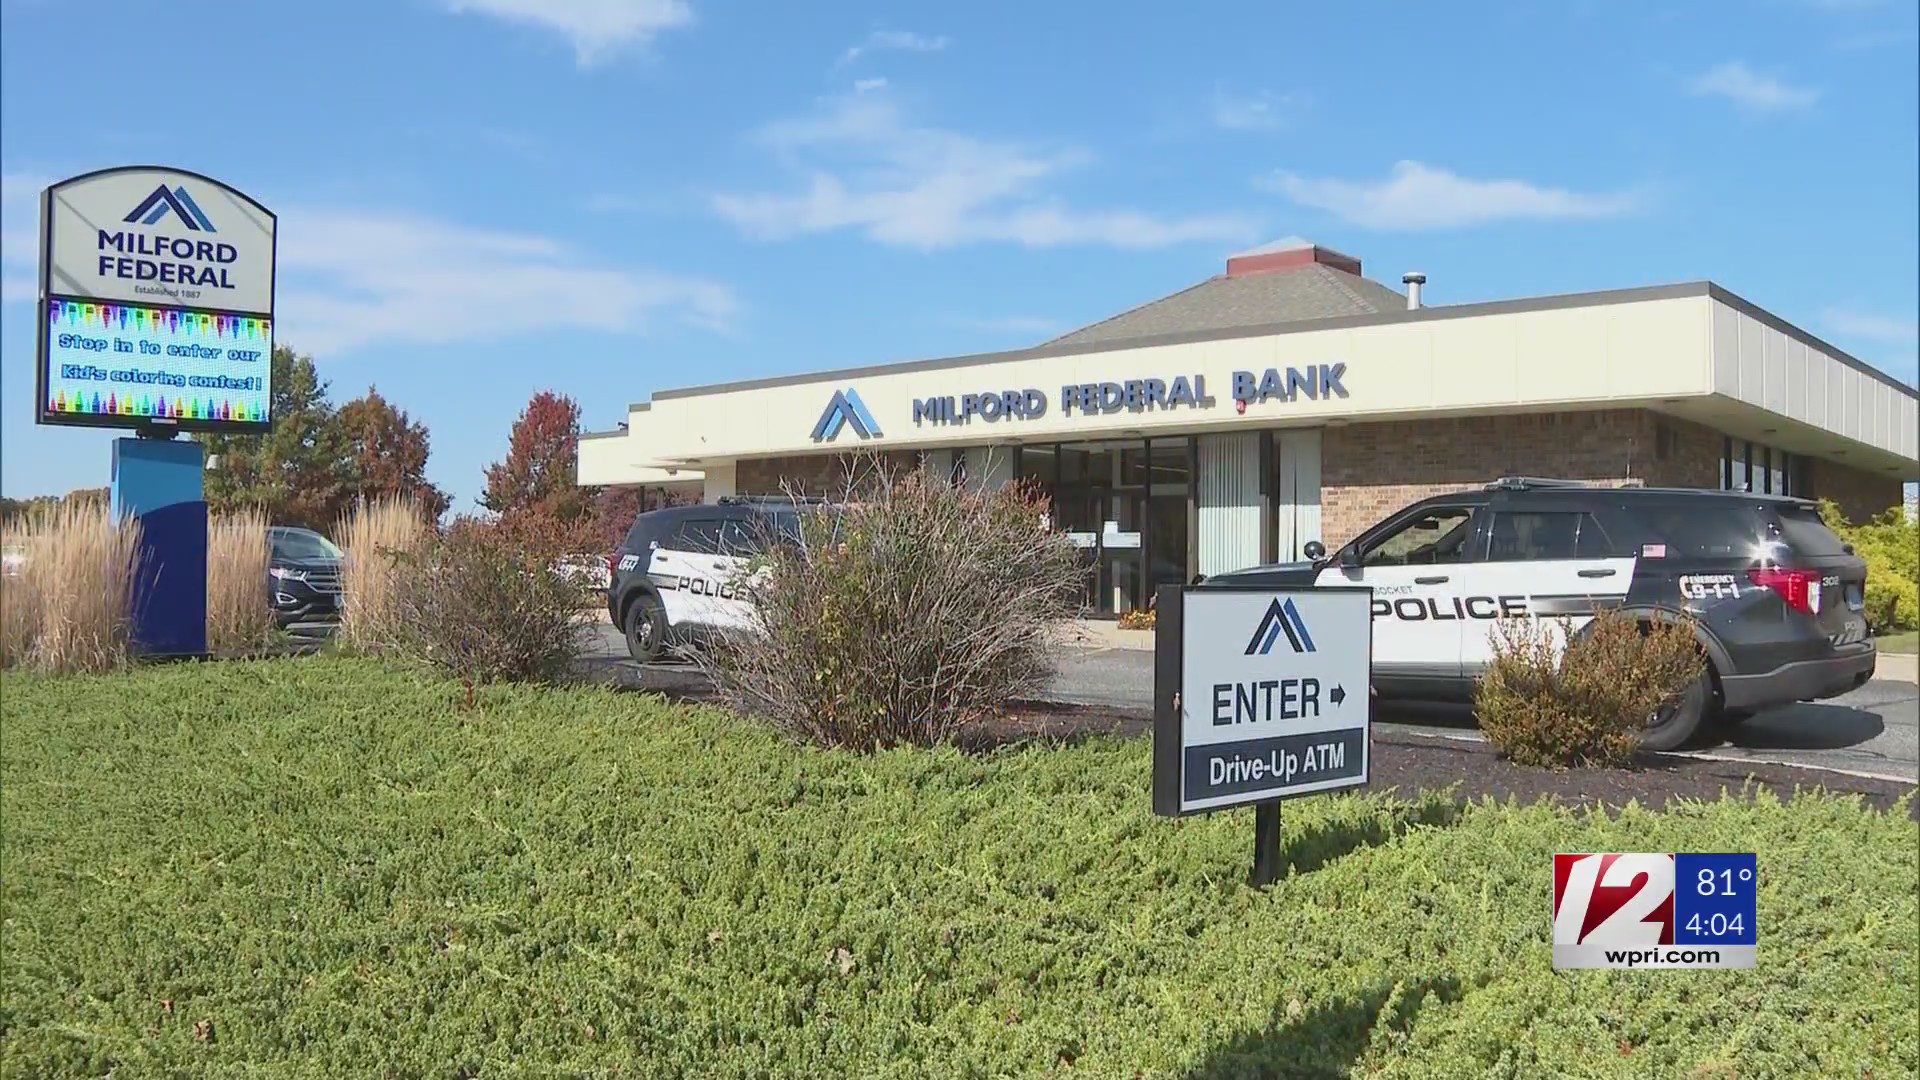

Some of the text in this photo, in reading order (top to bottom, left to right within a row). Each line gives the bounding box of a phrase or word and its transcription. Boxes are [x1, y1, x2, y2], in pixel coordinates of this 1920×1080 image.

[98, 229, 238, 264] MILFORD
[98, 255, 236, 289] FEDERAL
[134, 285, 201, 299] Established 1887
[59, 333, 261, 362] Stop in to enter our
[61, 363, 107, 381] Kid's
[110, 368, 186, 388] coloring
[912, 362, 1350, 428] MILFORD FEDERAL BANK
[1372, 596, 1531, 621] POLICE
[1212, 677, 1321, 727] ENTER
[1209, 741, 1345, 786] Drive-Up ATM
